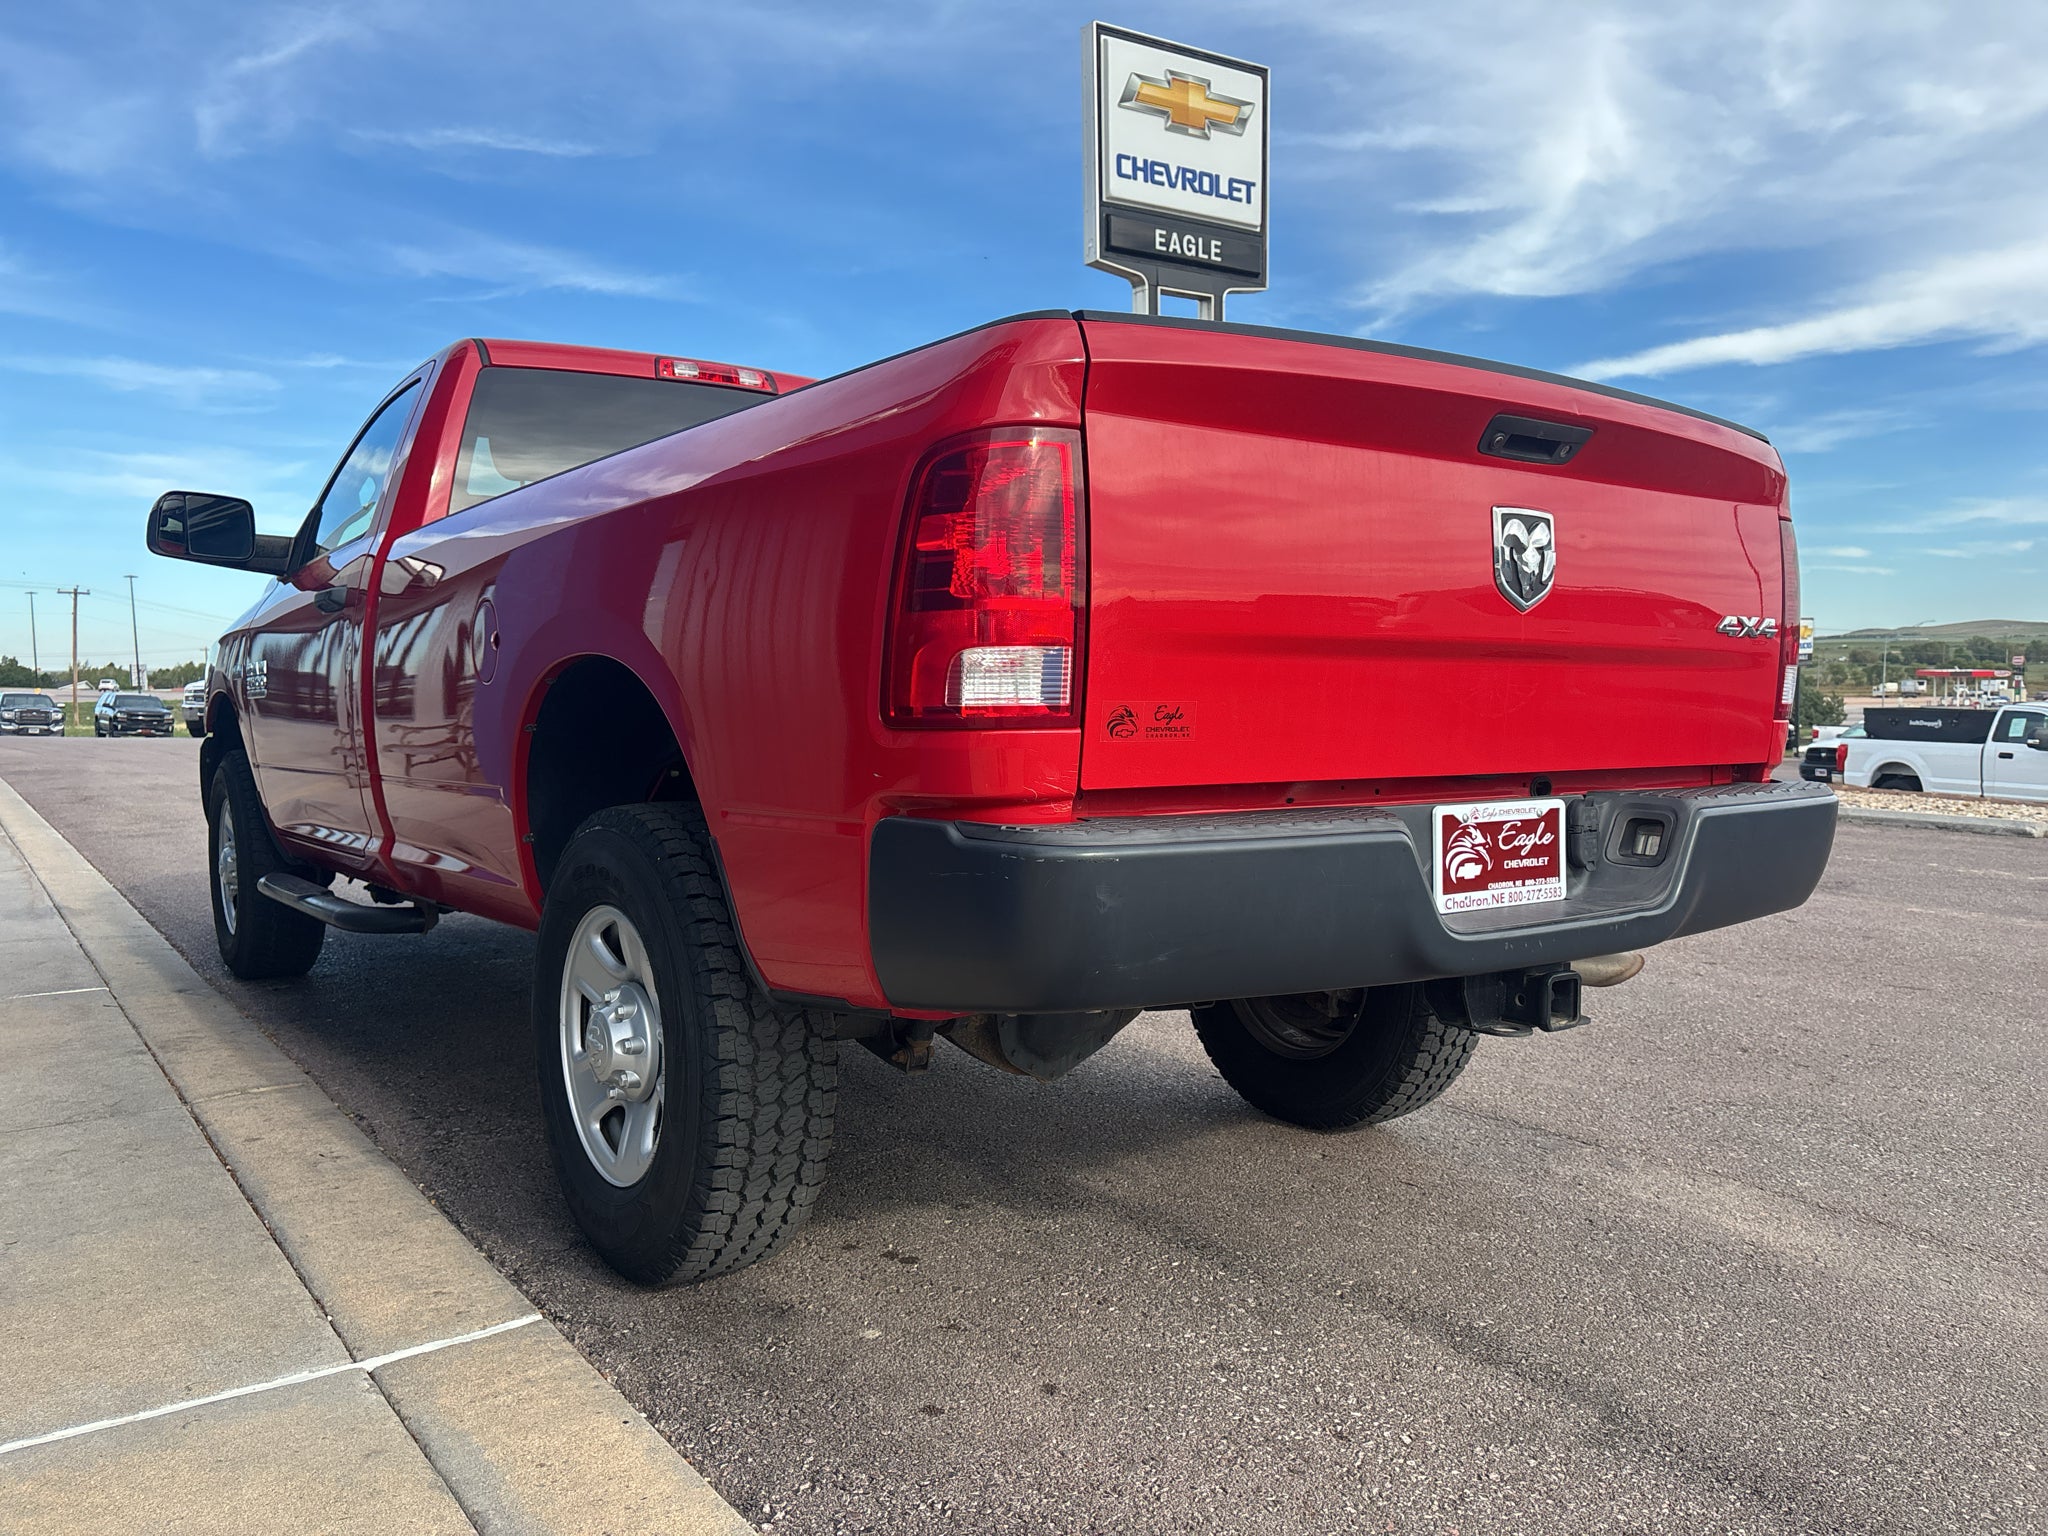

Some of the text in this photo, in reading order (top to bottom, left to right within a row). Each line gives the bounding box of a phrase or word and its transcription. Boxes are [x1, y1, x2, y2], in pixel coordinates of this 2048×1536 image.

[1116, 153, 1256, 204] CHEVROLET
[1154, 228, 1222, 262] EAGLE
[1154, 704, 1184, 725] Eagle
[1481, 807, 1536, 820] Eagle CHEVROLET
[1497, 821, 1555, 856] Eagle
[1503, 856, 1550, 869] CHEVROLET
[1491, 892, 1505, 905] NE
[1508, 886, 1563, 903] 800-272-5583
